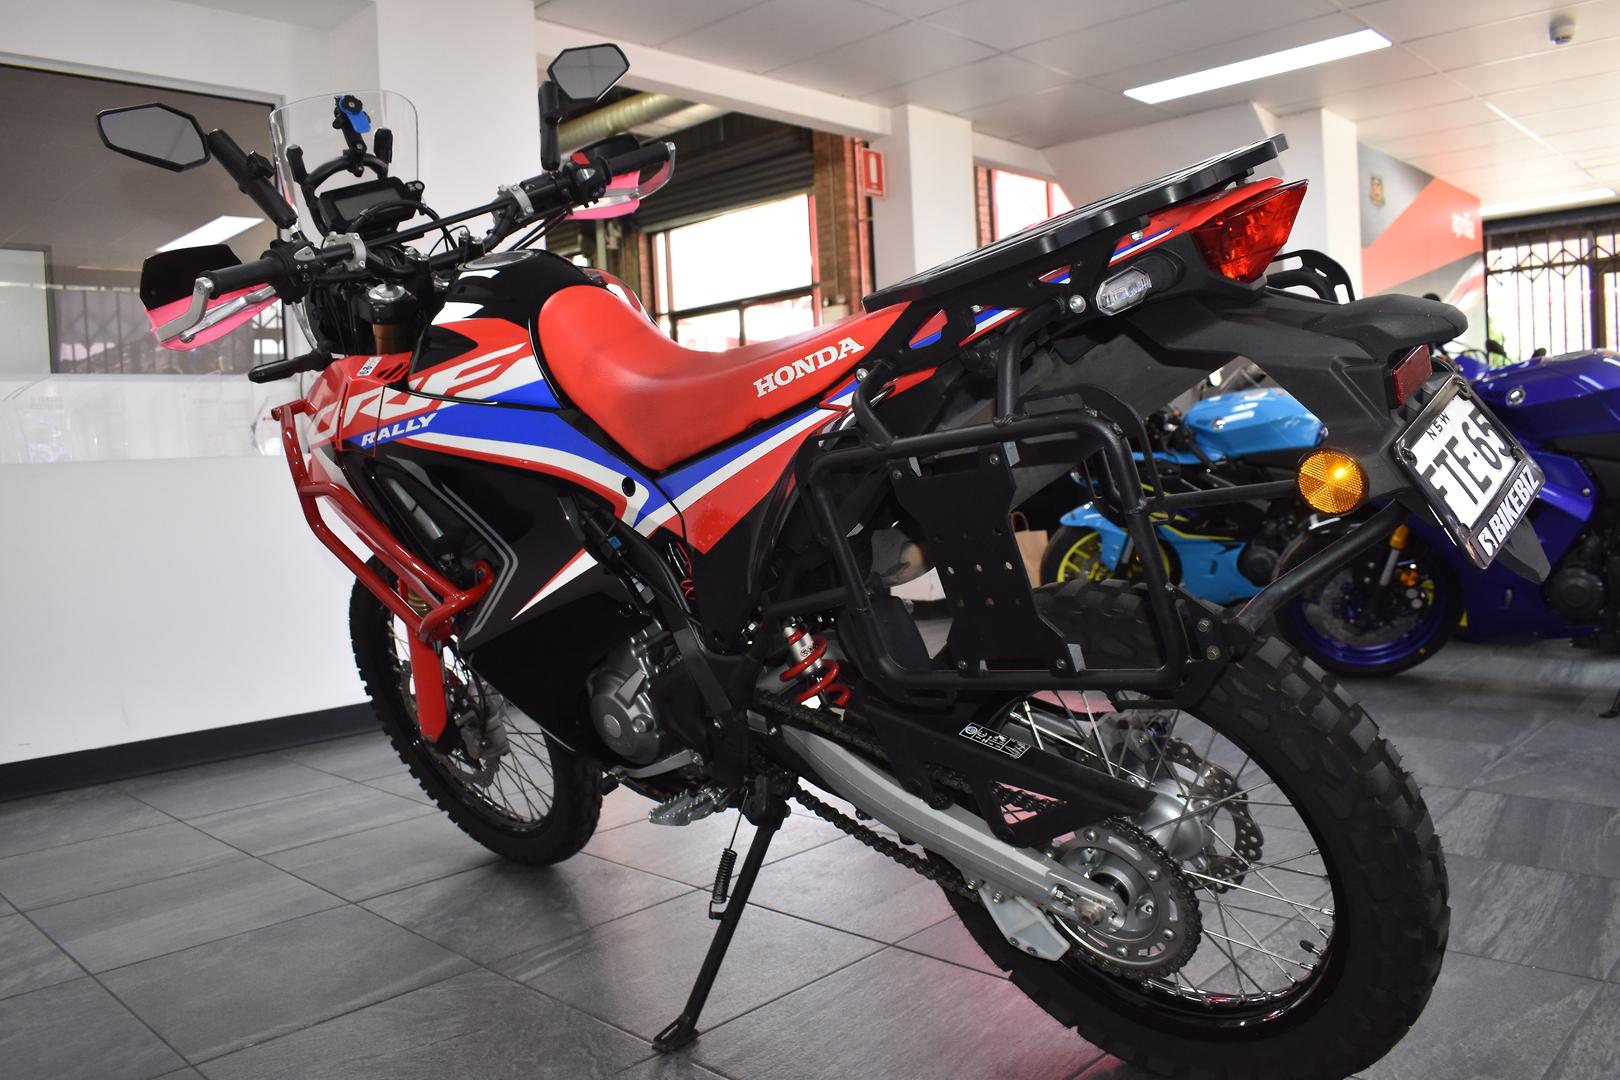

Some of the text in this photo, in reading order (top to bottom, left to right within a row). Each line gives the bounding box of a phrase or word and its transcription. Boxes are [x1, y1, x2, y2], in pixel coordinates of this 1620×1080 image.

[753, 336, 864, 398] HONDA
[361, 412, 438, 447] RALLY
[1425, 411, 1450, 441] NSW
[1488, 464, 1540, 544] BIKEBIZ
